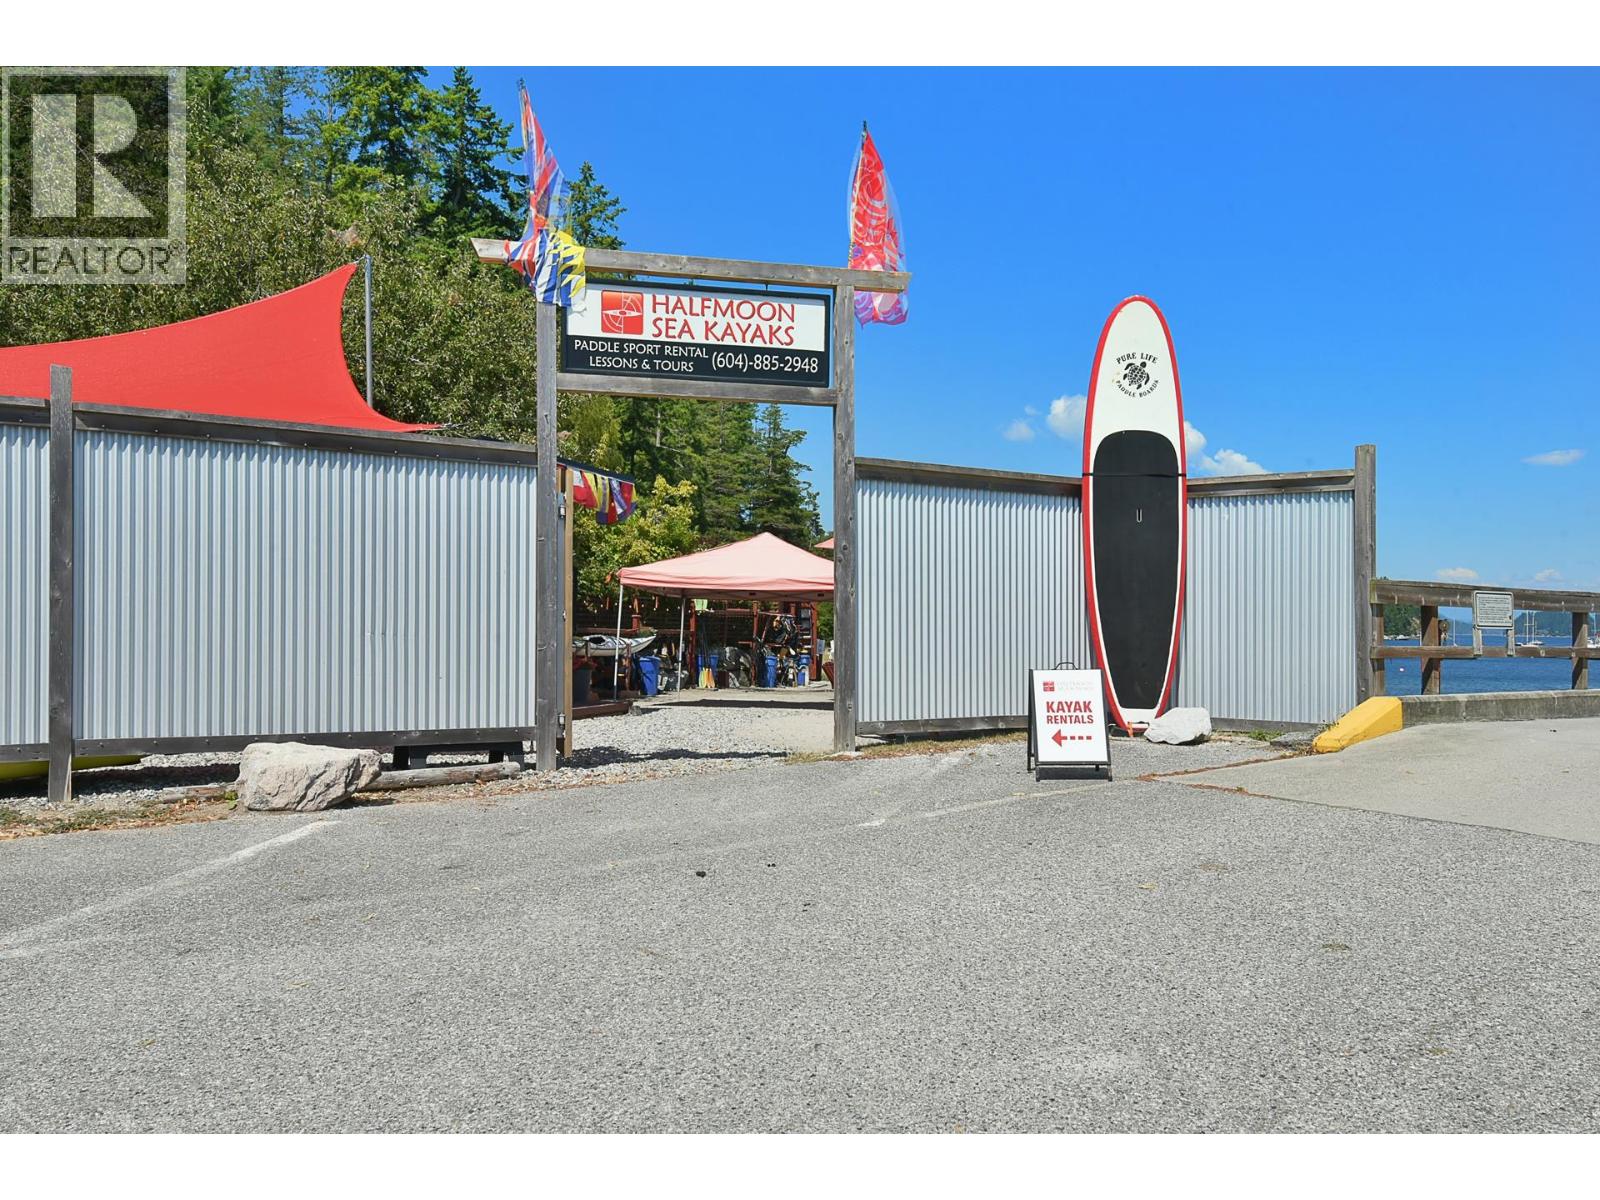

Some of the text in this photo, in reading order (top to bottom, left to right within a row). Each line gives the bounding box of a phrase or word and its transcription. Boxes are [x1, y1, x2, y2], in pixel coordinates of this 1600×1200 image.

[651, 295, 796, 323] HALFMOON
[651, 317, 795, 347] SEA KAYAKS
[574, 340, 709, 359] PADDLE SPORT RENTAL
[1116, 352, 1158, 364] PURE LIFE
[589, 355, 694, 372] LESSONS & TOURS
[711, 351, 819, 374] (604)-885-2948
[1046, 701, 1093, 713] KAYAK
[1046, 714, 1094, 725] RENTALS
